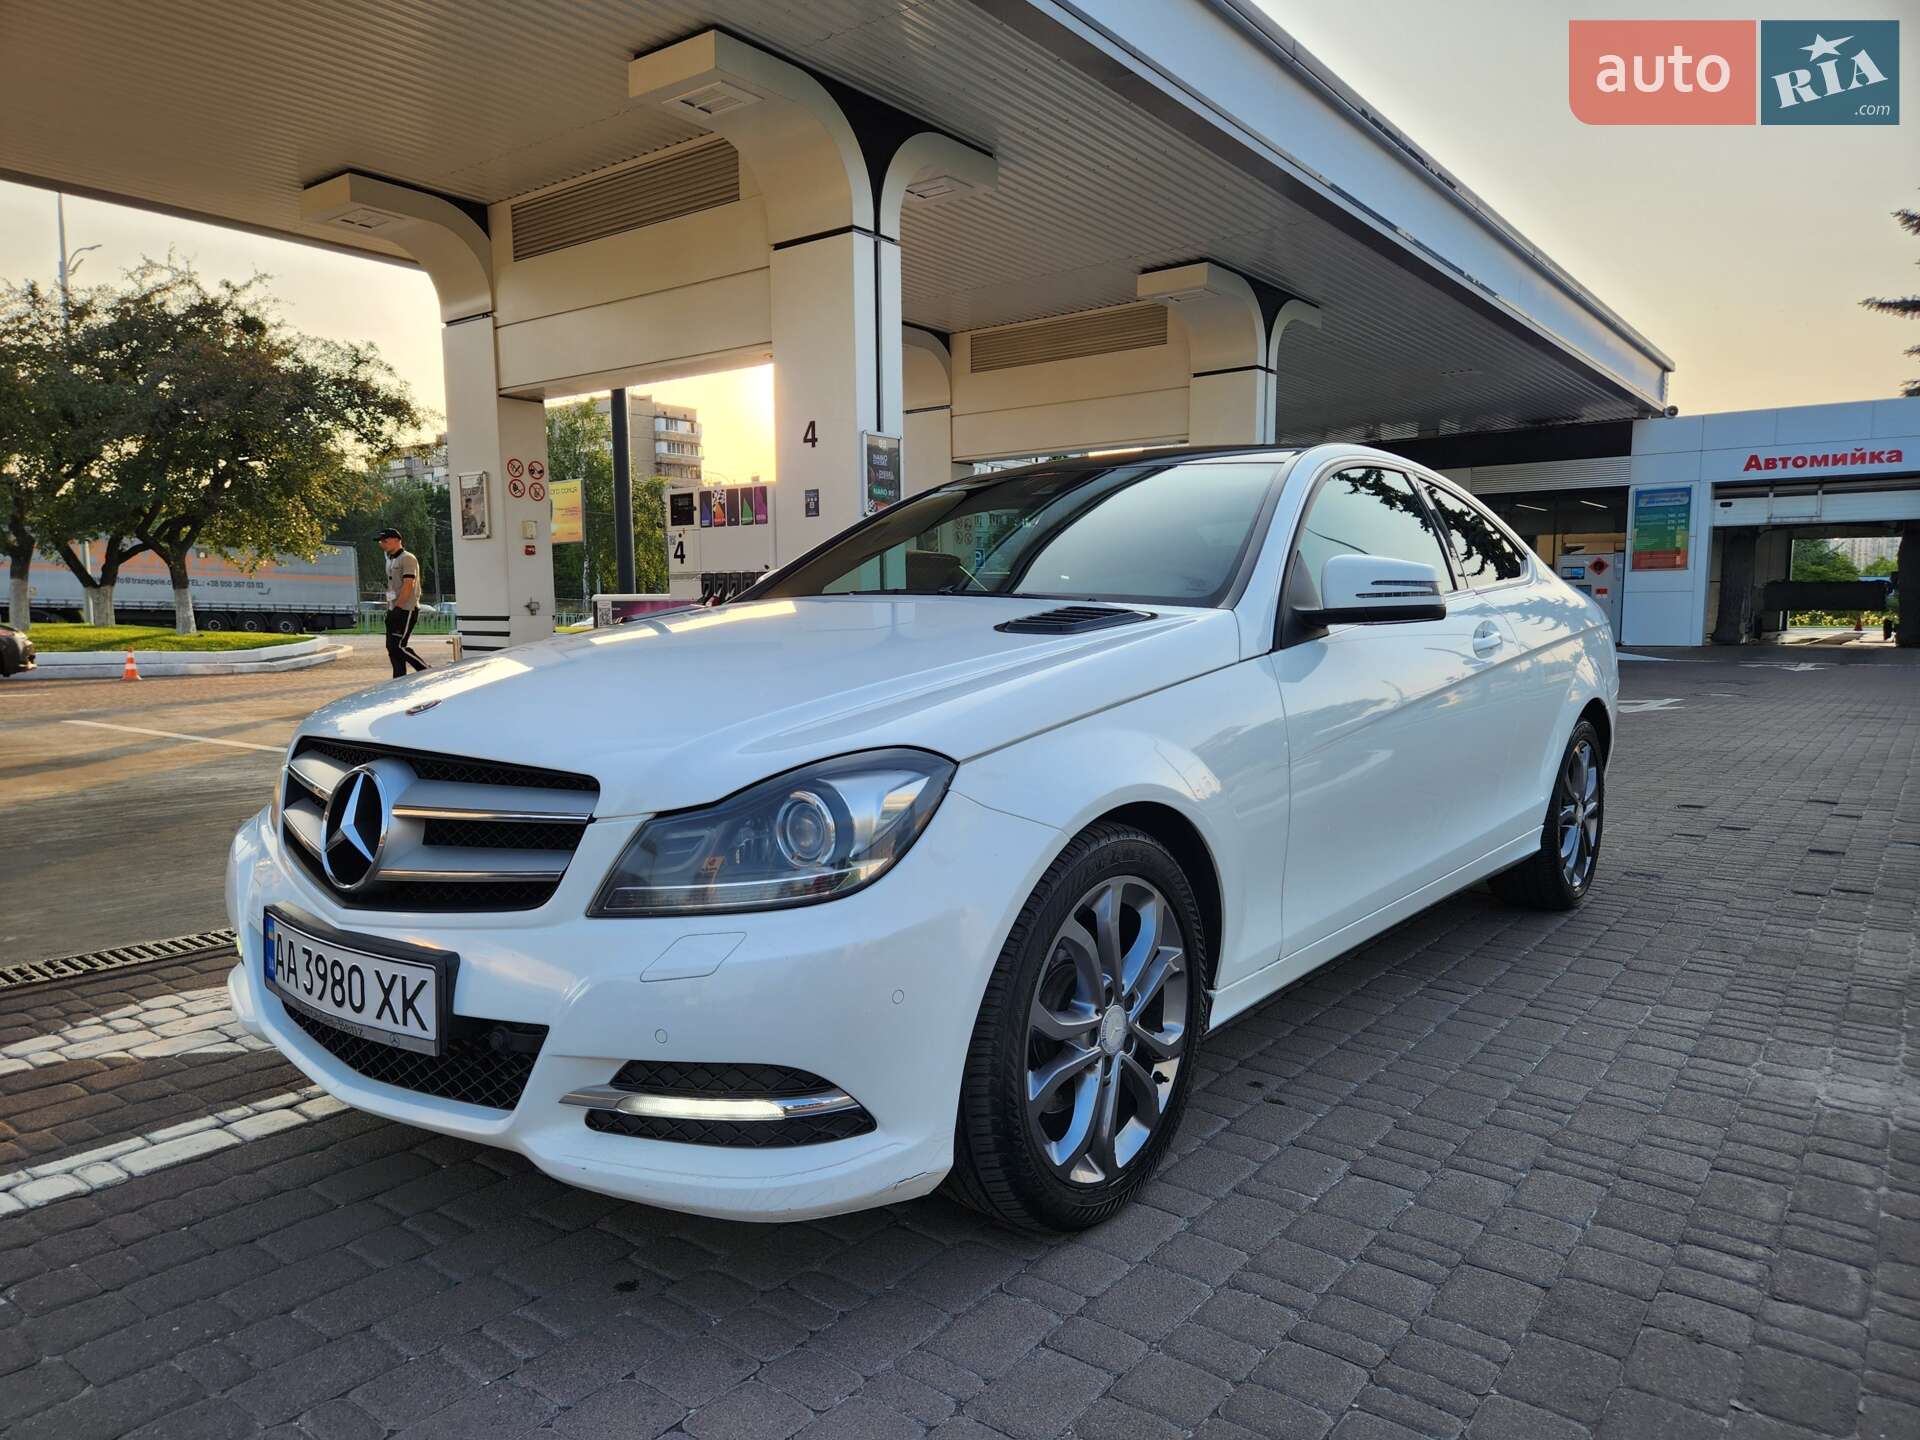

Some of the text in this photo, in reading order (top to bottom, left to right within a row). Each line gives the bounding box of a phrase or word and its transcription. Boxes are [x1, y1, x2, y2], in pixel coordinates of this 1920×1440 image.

[803, 420, 818, 448] 4
[1743, 447, 1904, 472] Автомийка
[673, 541, 686, 564] 4
[275, 934, 299, 989] AA
[302, 946, 365, 1014] 3980
[374, 969, 429, 1032] XK
